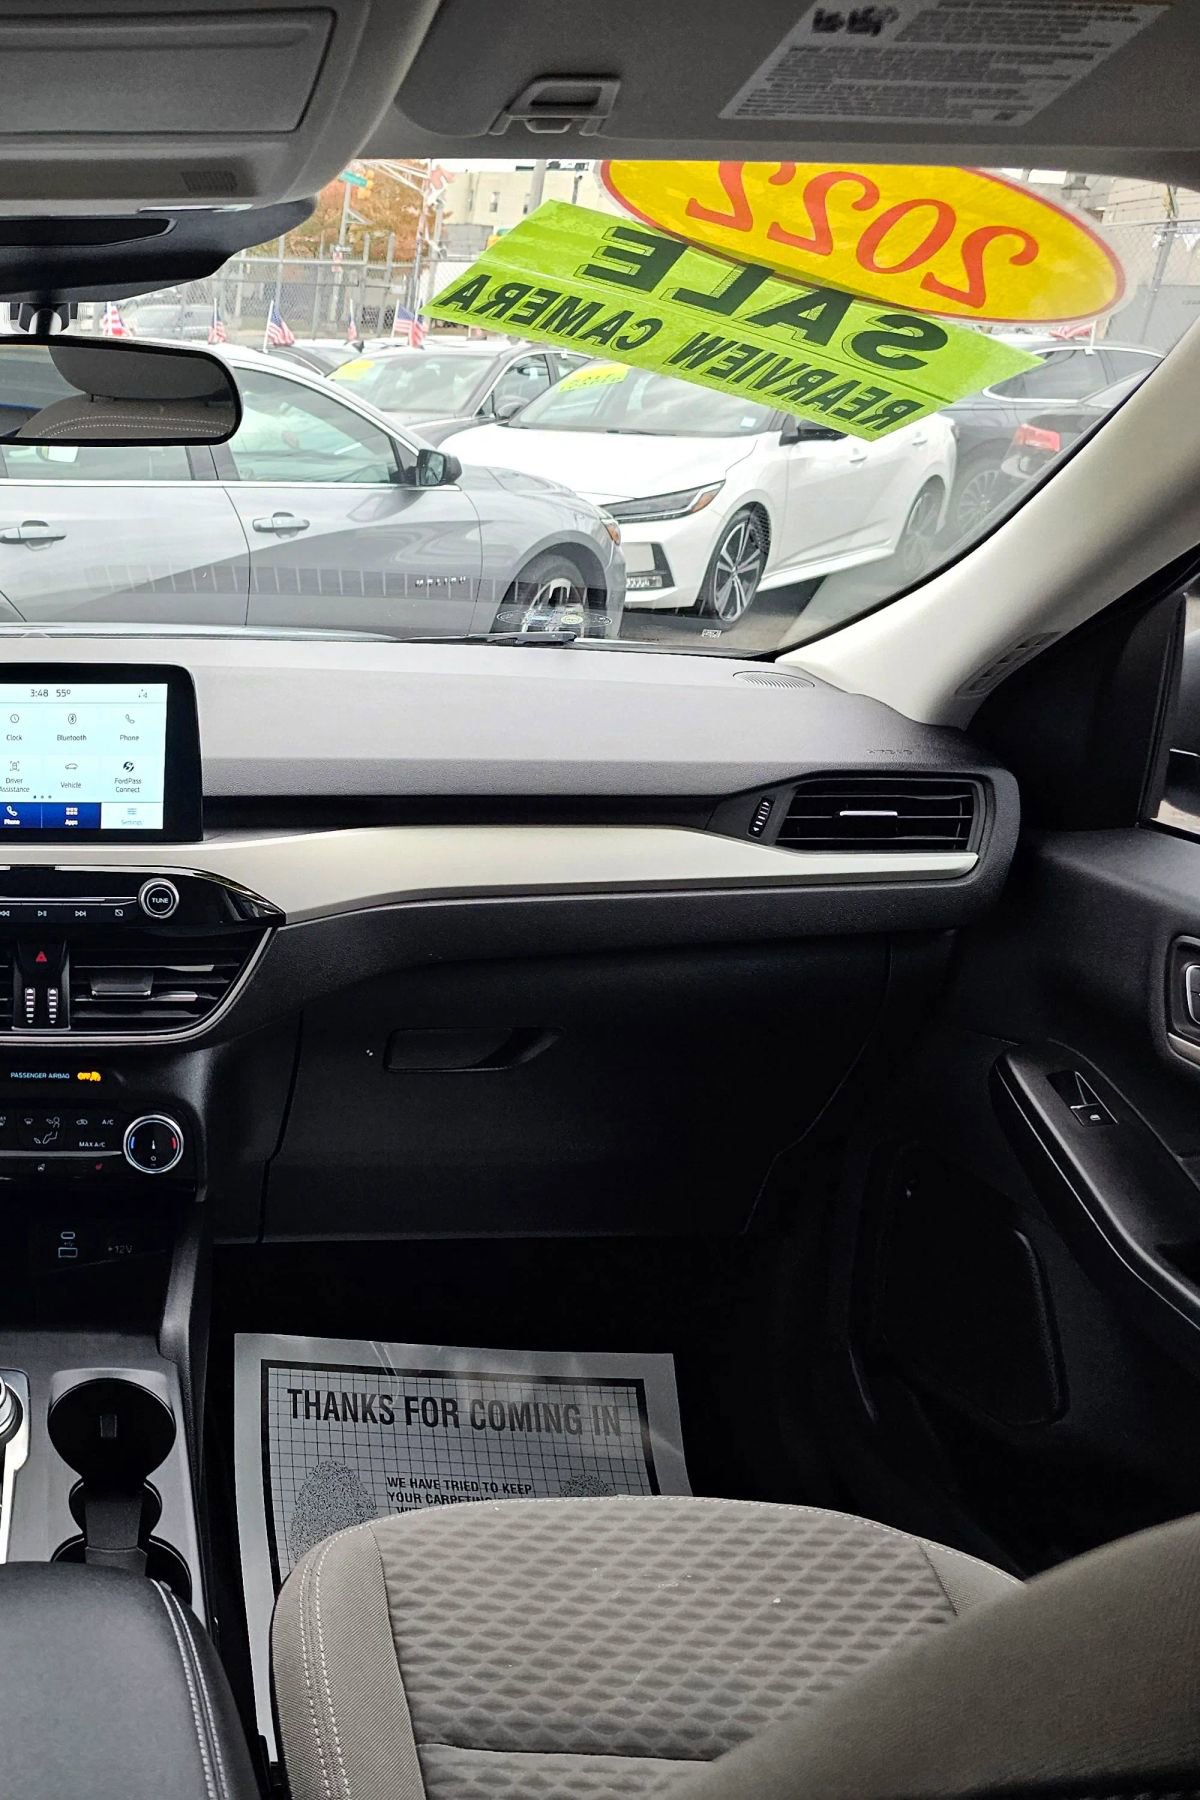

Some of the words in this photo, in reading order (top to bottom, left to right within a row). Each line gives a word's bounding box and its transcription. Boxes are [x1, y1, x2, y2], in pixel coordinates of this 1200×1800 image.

[30, 689, 49, 698] 3:48
[6, 733, 23, 741] Clock
[60, 781, 82, 789] Vehicle
[114, 777, 142, 785] FordPass
[101, 1118, 114, 1126] A/C
[287, 1388, 396, 1426] THANKS
[404, 1396, 460, 1429] FOR
[469, 1399, 583, 1436] COMING
[591, 1404, 622, 1437] IN
[386, 1477, 406, 1488] WE
[409, 1478, 440, 1490] HAVE
[443, 1480, 479, 1492] TRIED
[483, 1482, 498, 1493] TO
[502, 1483, 532, 1495] KEEP
[387, 1491, 422, 1504] YOUR
[425, 1493, 493, 1506] CARPE
